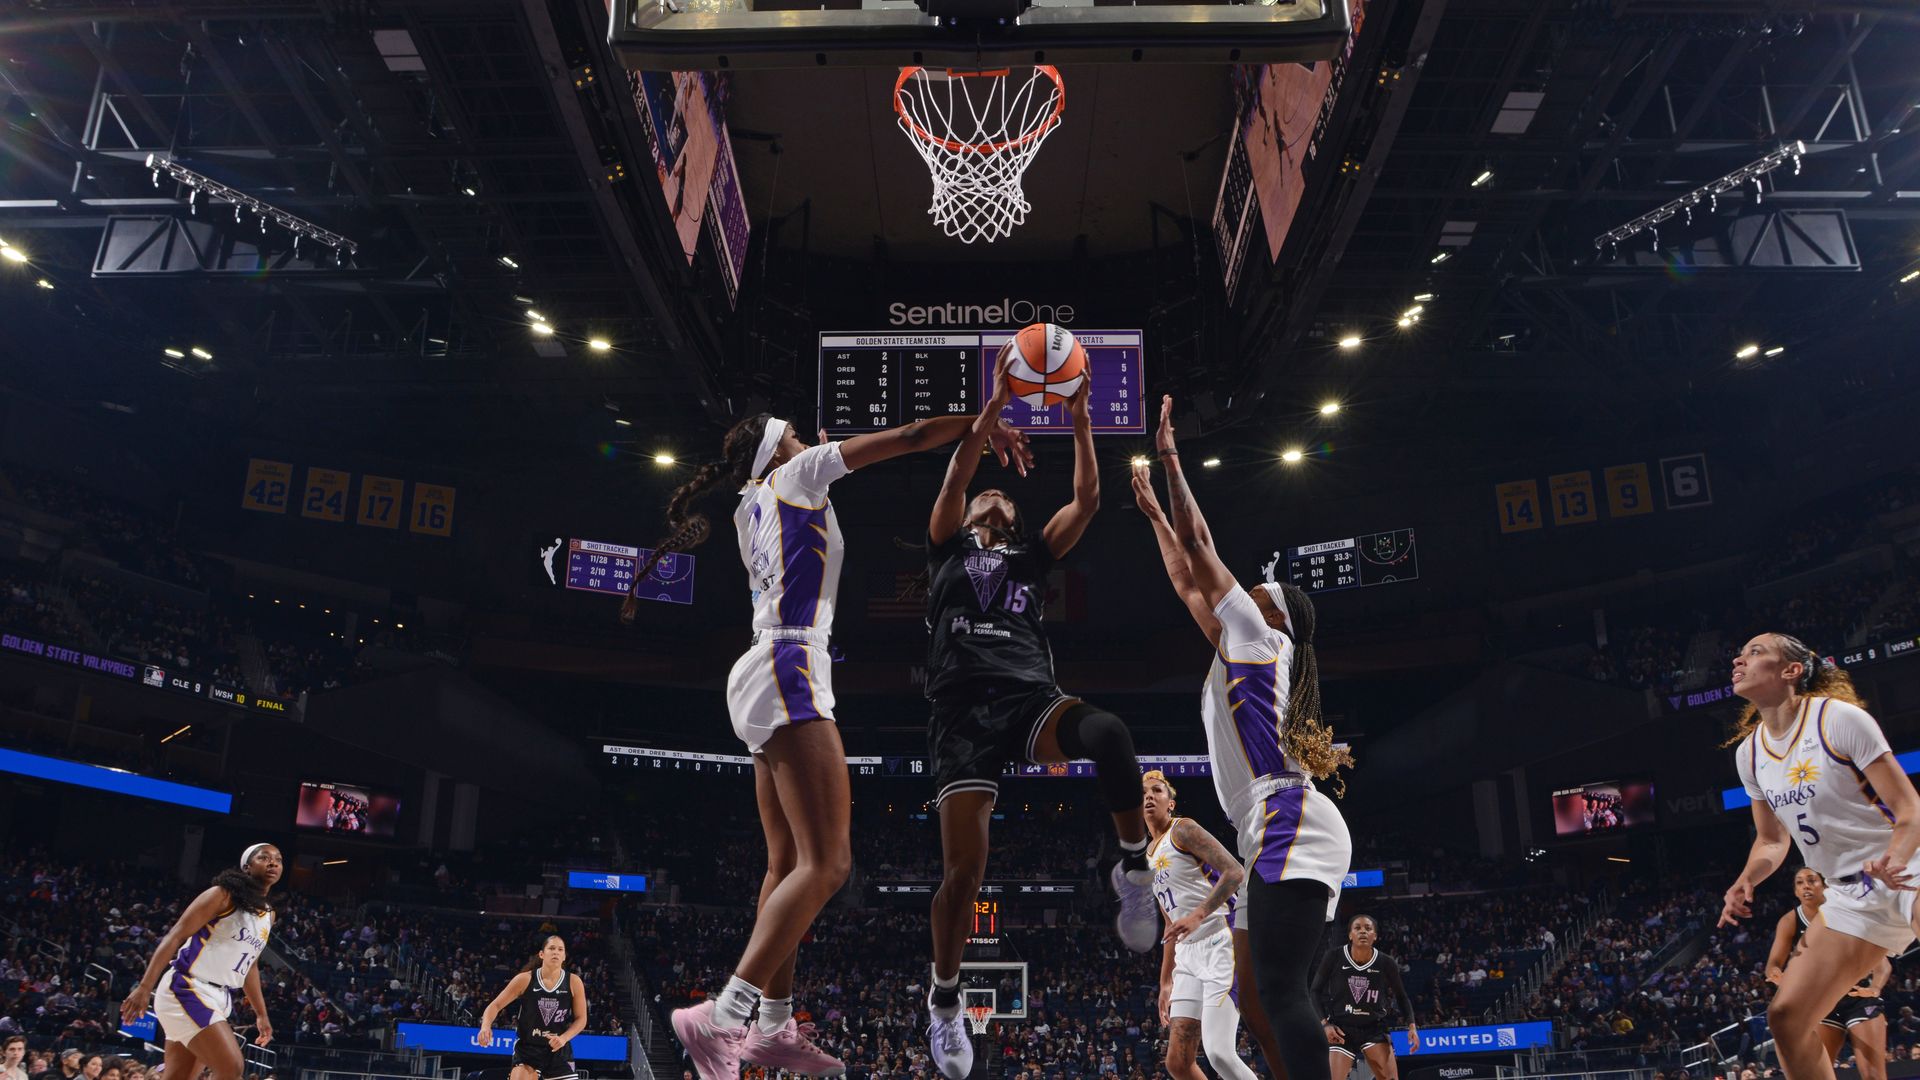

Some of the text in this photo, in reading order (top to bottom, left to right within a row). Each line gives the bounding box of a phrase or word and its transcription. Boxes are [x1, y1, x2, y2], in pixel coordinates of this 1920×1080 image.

[889, 298, 1075, 325] SentinelOne
[856, 337, 946, 346] GOLDEN STATE TEAM STATS
[1083, 336, 1104, 344] STATS
[882, 352, 888, 360] 2
[960, 351, 966, 360] 0
[1122, 351, 1127, 359] 1
[882, 365, 888, 373] 2
[960, 364, 966, 373] 7
[1121, 363, 1127, 372] 5
[878, 378, 888, 387] 12
[961, 377, 966, 386] 1
[1121, 376, 1127, 385] 4
[881, 391, 888, 399] 4
[960, 390, 966, 399] 8
[1118, 390, 1128, 398] 18
[869, 404, 887, 413] 66.7
[948, 403, 966, 412] 33.3
[1110, 402, 1128, 412] 39.3
[873, 417, 887, 426] 0.0
[1031, 416, 1050, 425] 20.0
[1115, 416, 1129, 425] 0.0
[1672, 465, 1699, 497] 6
[249, 479, 286, 507] 42
[1621, 484, 1639, 509] 9
[307, 487, 342, 515] 24
[1559, 491, 1588, 518] 13
[366, 495, 394, 522] 17
[1505, 499, 1535, 526] 14
[417, 502, 447, 529] 16
[586, 542, 629, 555] SHOT TRACKER
[1303, 541, 1346, 554] SHOT TRACKER
[590, 555, 608, 564] 11/28
[590, 567, 606, 576] 2/10
[1311, 568, 1323, 577] 0/9
[589, 578, 600, 587] 0/1
[1312, 580, 1324, 589] 4/7
[1004, 580, 1028, 614] 15
[1891, 640, 1915, 653] WSH
[2, 633, 136, 678] GOLDEN STATE VALKYRIES
[1843, 649, 1876, 664] CLE 9
[172, 678, 202, 693] CLE 9
[214, 688, 246, 704] WSH 10
[1687, 688, 1722, 706] GOLDEN
[256, 699, 285, 711] FINAL
[612, 756, 741, 774] 2 2 12 4 0 7 1
[860, 766, 874, 774] 57.1
[909, 760, 923, 773] 16
[1077, 766, 1082, 774] 8
[1766, 784, 1816, 812] SPARKS
[1796, 813, 1820, 845] 5
[1157, 887, 1178, 913] 21
[975, 913, 994, 934] 11
[1366, 989, 1379, 1003] 14
[1426, 1034, 1493, 1047] UNITED
[1439, 1067, 1473, 1077] Rakuten
